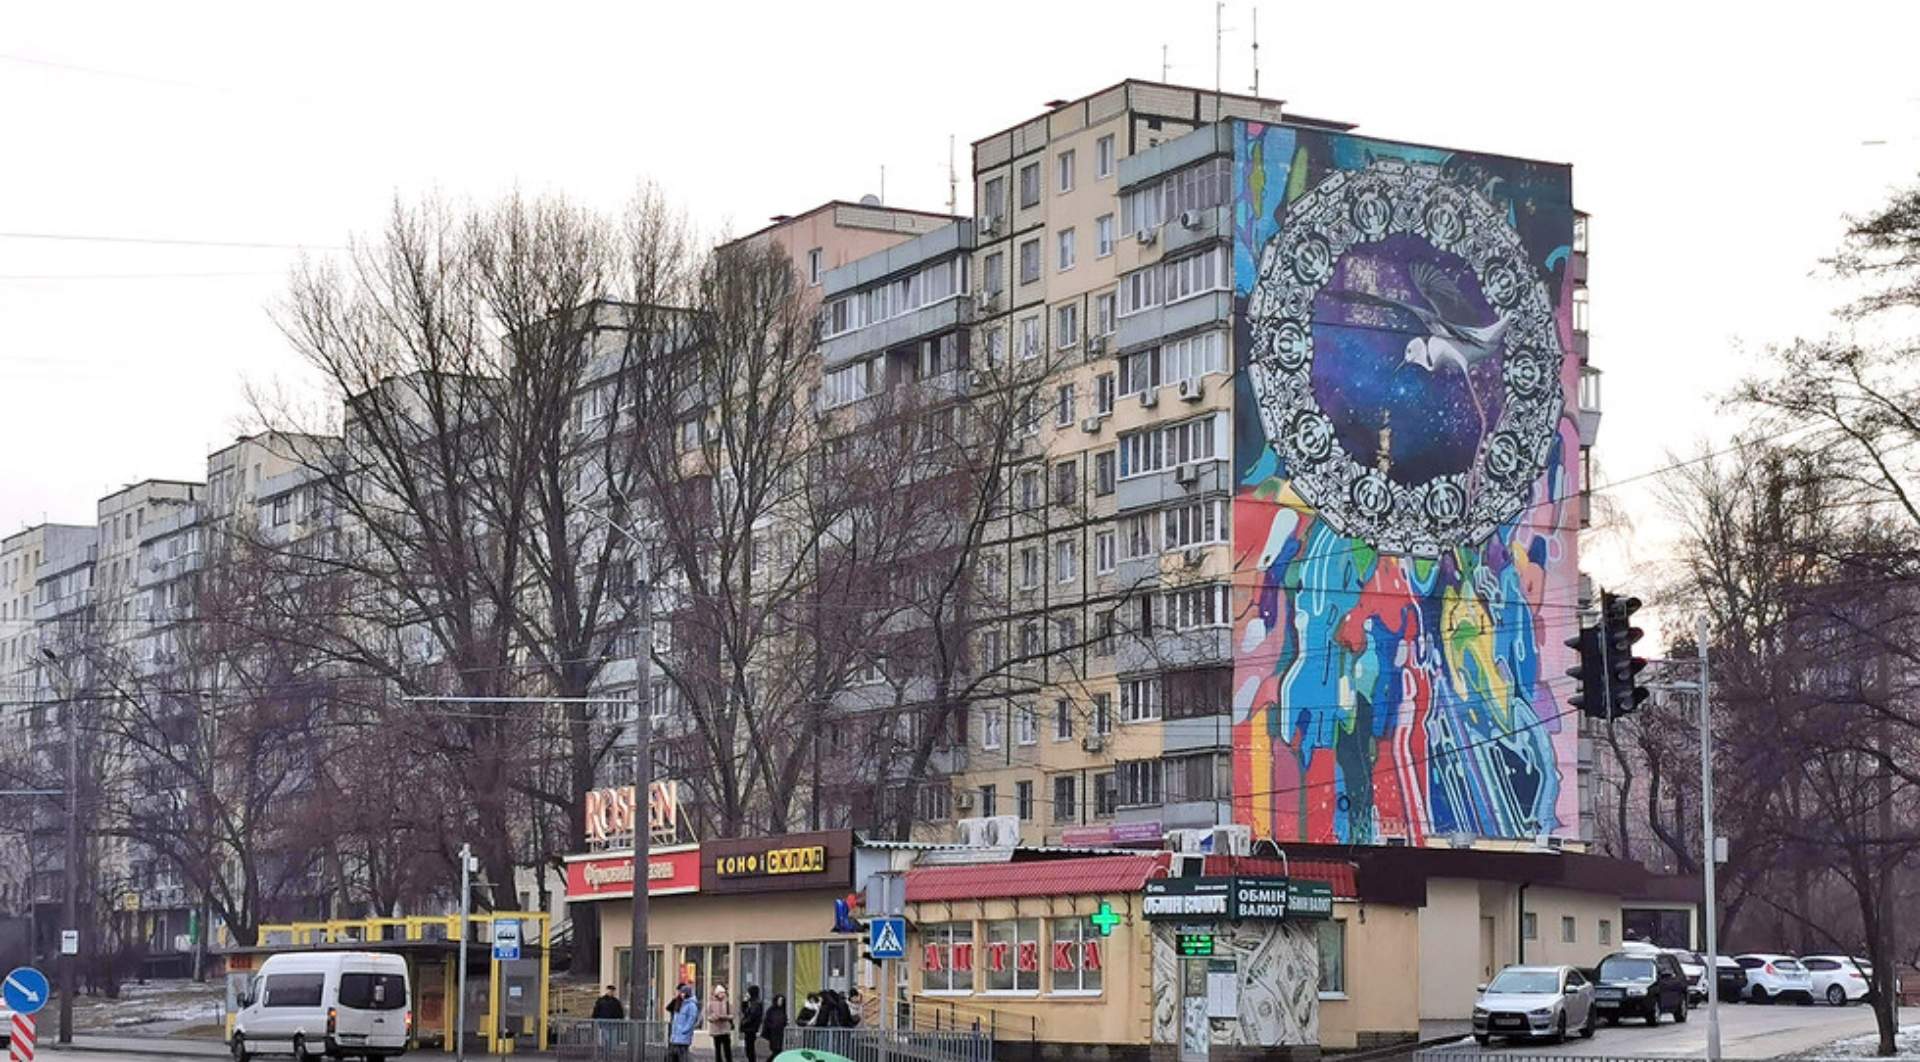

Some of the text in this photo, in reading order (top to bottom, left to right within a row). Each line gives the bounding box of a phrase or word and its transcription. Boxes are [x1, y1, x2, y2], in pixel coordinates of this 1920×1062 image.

[1238, 889, 1286, 902] ОБМІН
[1239, 903, 1286, 917] ВАЛЮТ
[924, 940, 1101, 972] АПТЕКА
